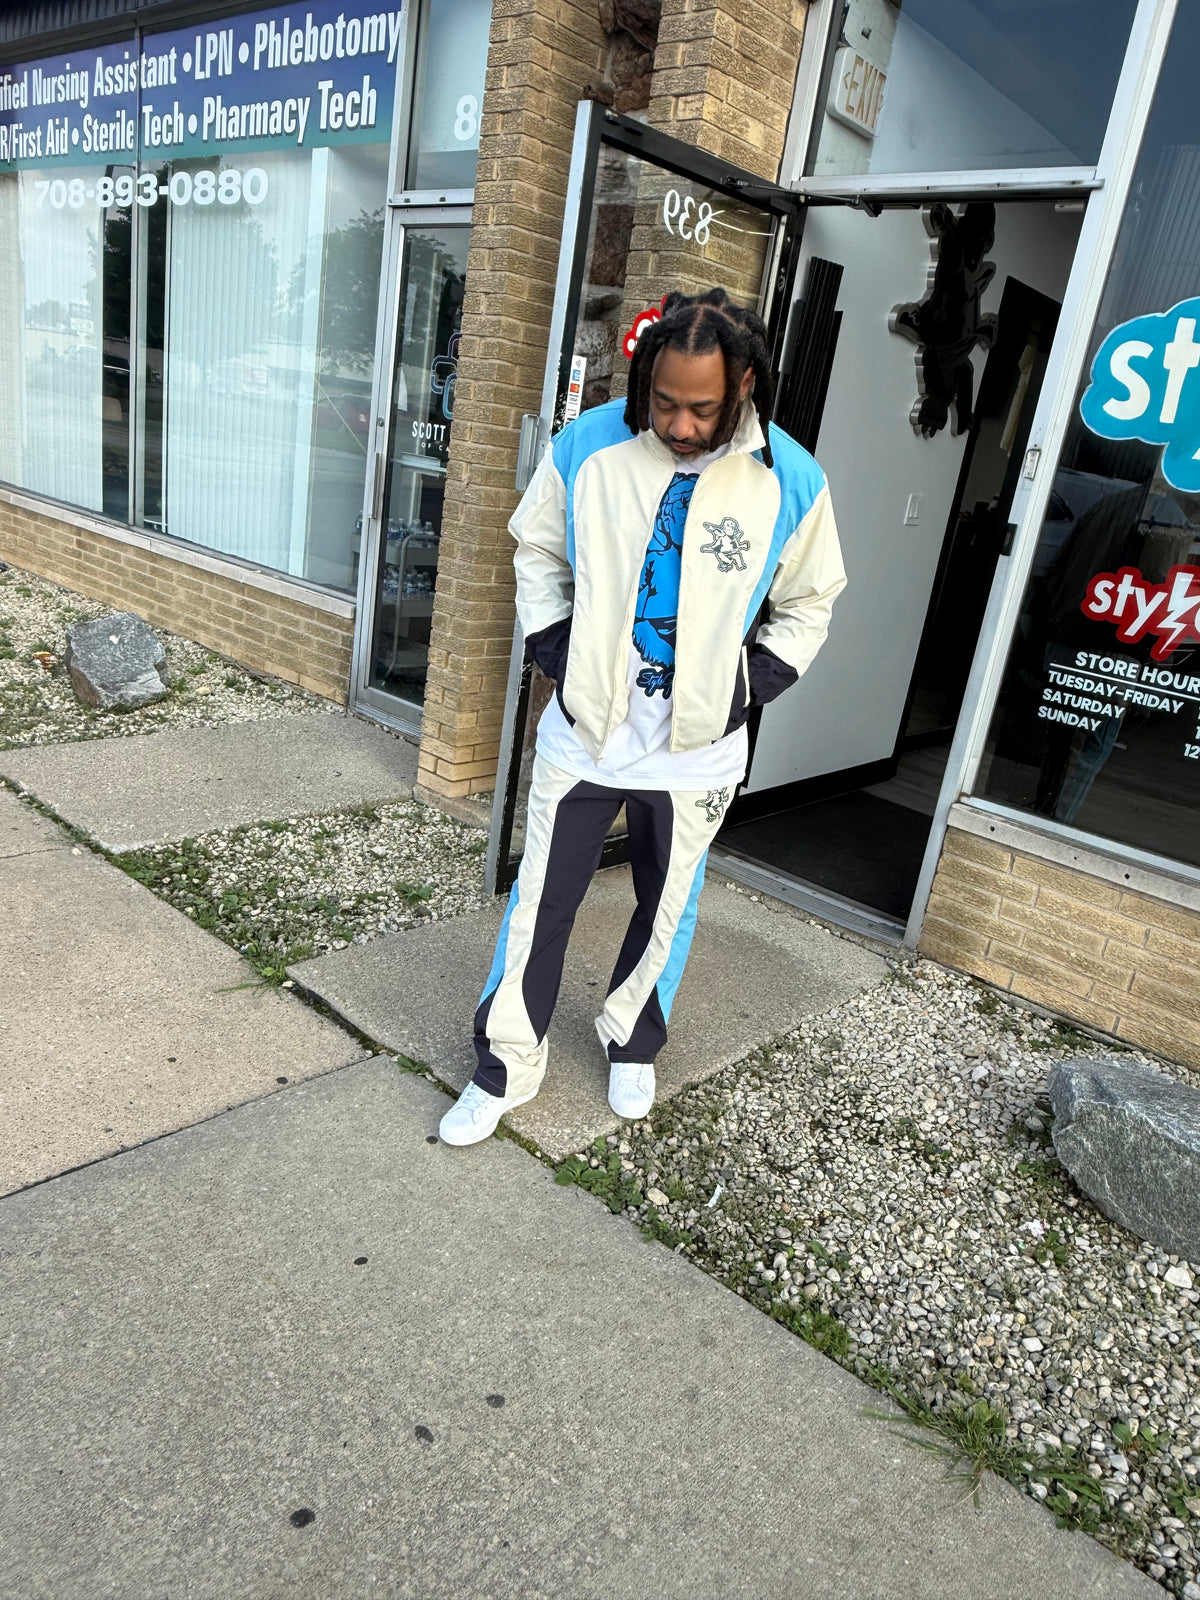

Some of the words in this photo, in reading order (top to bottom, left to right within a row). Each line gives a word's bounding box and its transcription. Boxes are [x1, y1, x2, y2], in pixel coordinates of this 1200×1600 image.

[32, 63, 89, 108] Nursing
[93, 46, 178, 97] Assistant
[194, 29, 234, 80] LPN
[253, 11, 402, 71] Phlebotomy
[845, 54, 887, 129] EXIT
[45, 117, 69, 156] Aid
[82, 110, 135, 153] Sterile
[142, 101, 184, 147] Tech
[202, 95, 311, 145] Pharmacy
[318, 74, 377, 131] Tech
[453, 94, 478, 141] 8
[34, 167, 268, 210] 708-893-0880
[1102, 317, 1200, 460] st
[412, 420, 446, 442] SCOTT
[1075, 651, 1139, 679] STORE
[1037, 705, 1101, 732] SUNDAY
[1042, 688, 1125, 719] SATURDAY
